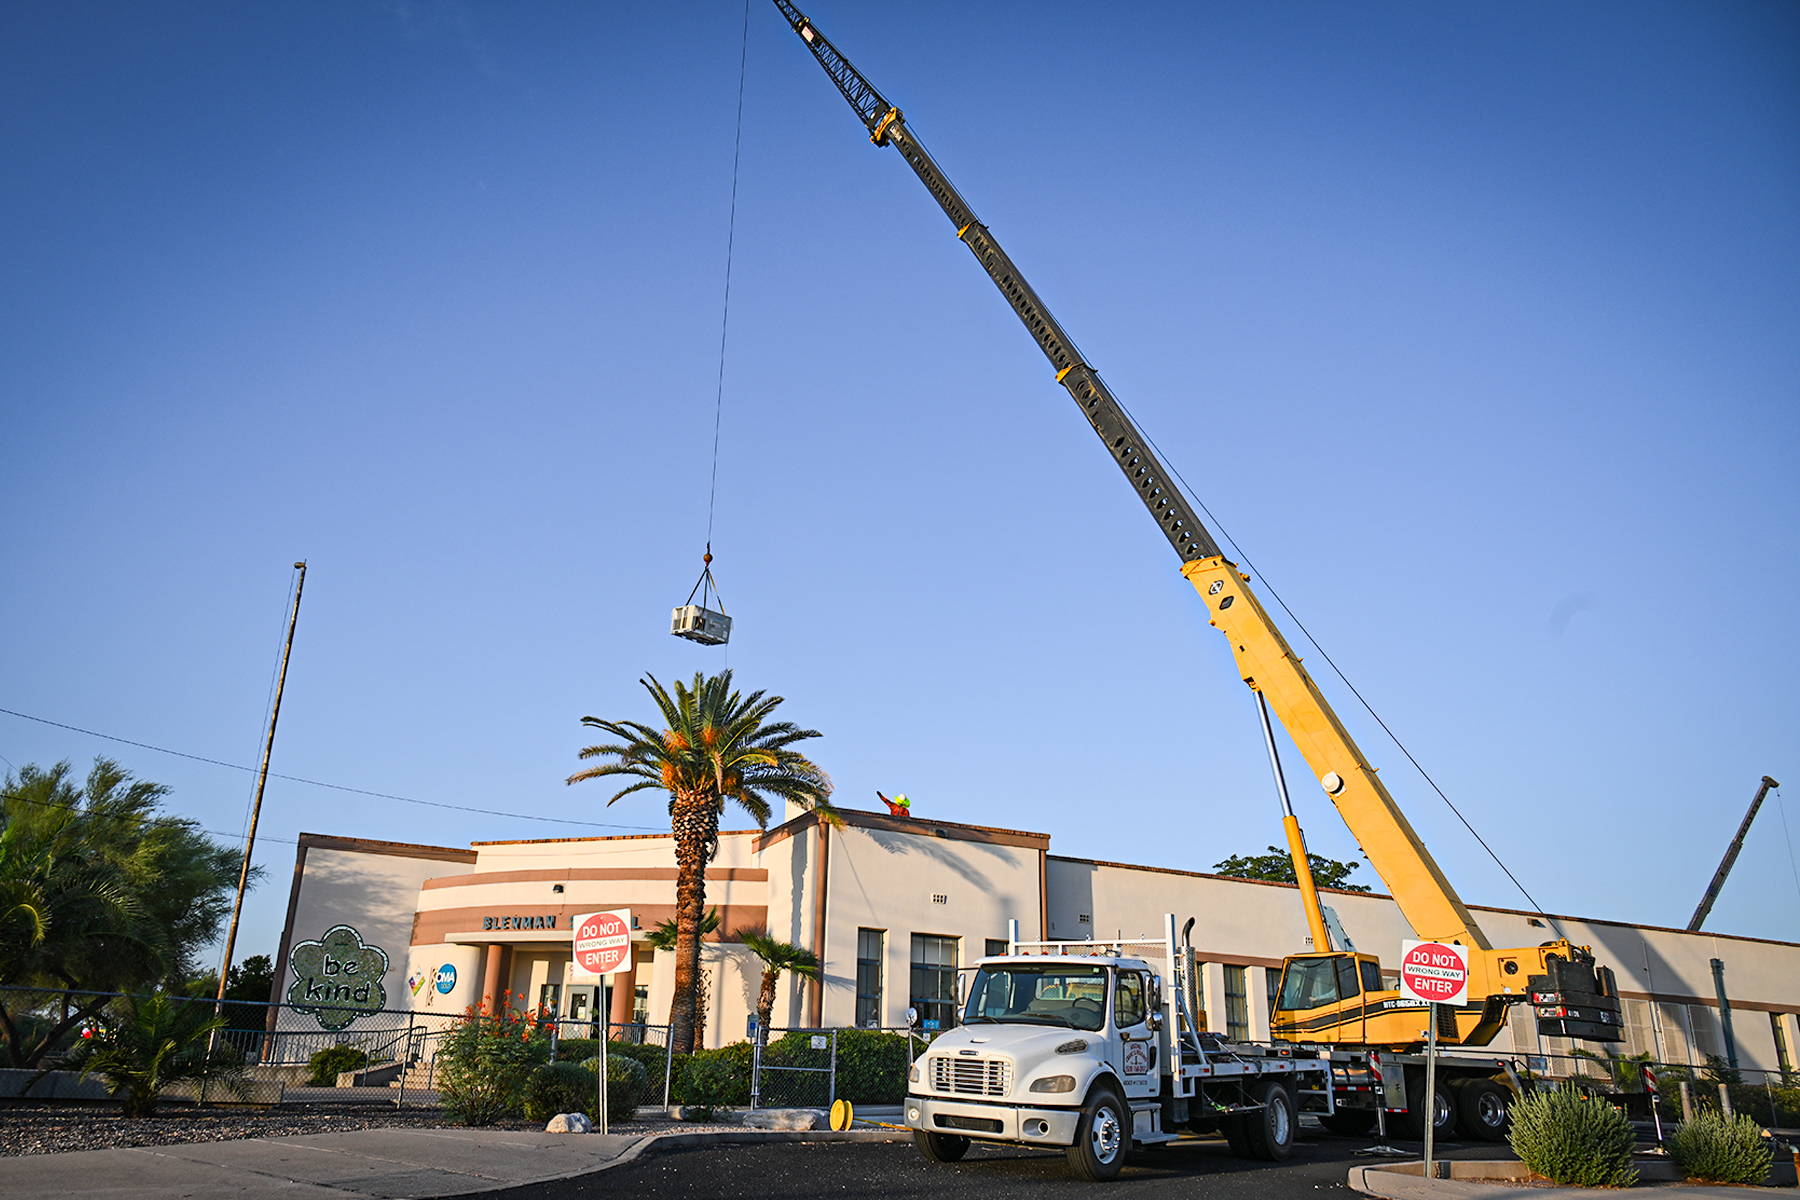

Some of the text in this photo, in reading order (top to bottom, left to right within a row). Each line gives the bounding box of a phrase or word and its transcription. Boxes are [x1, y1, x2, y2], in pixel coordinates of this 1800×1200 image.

[482, 914, 556, 930] BLENMAN
[582, 924, 598, 938] DO
[599, 921, 621, 936] NOT
[578, 937, 625, 949] WRONG WAY
[322, 953, 359, 978] be
[585, 949, 619, 966] ENTER
[1412, 951, 1457, 967] DO NOT
[436, 971, 455, 984] OMA
[1407, 966, 1461, 978] WRONG WAY
[304, 977, 372, 1004] kind
[1414, 977, 1453, 994] ENTER
